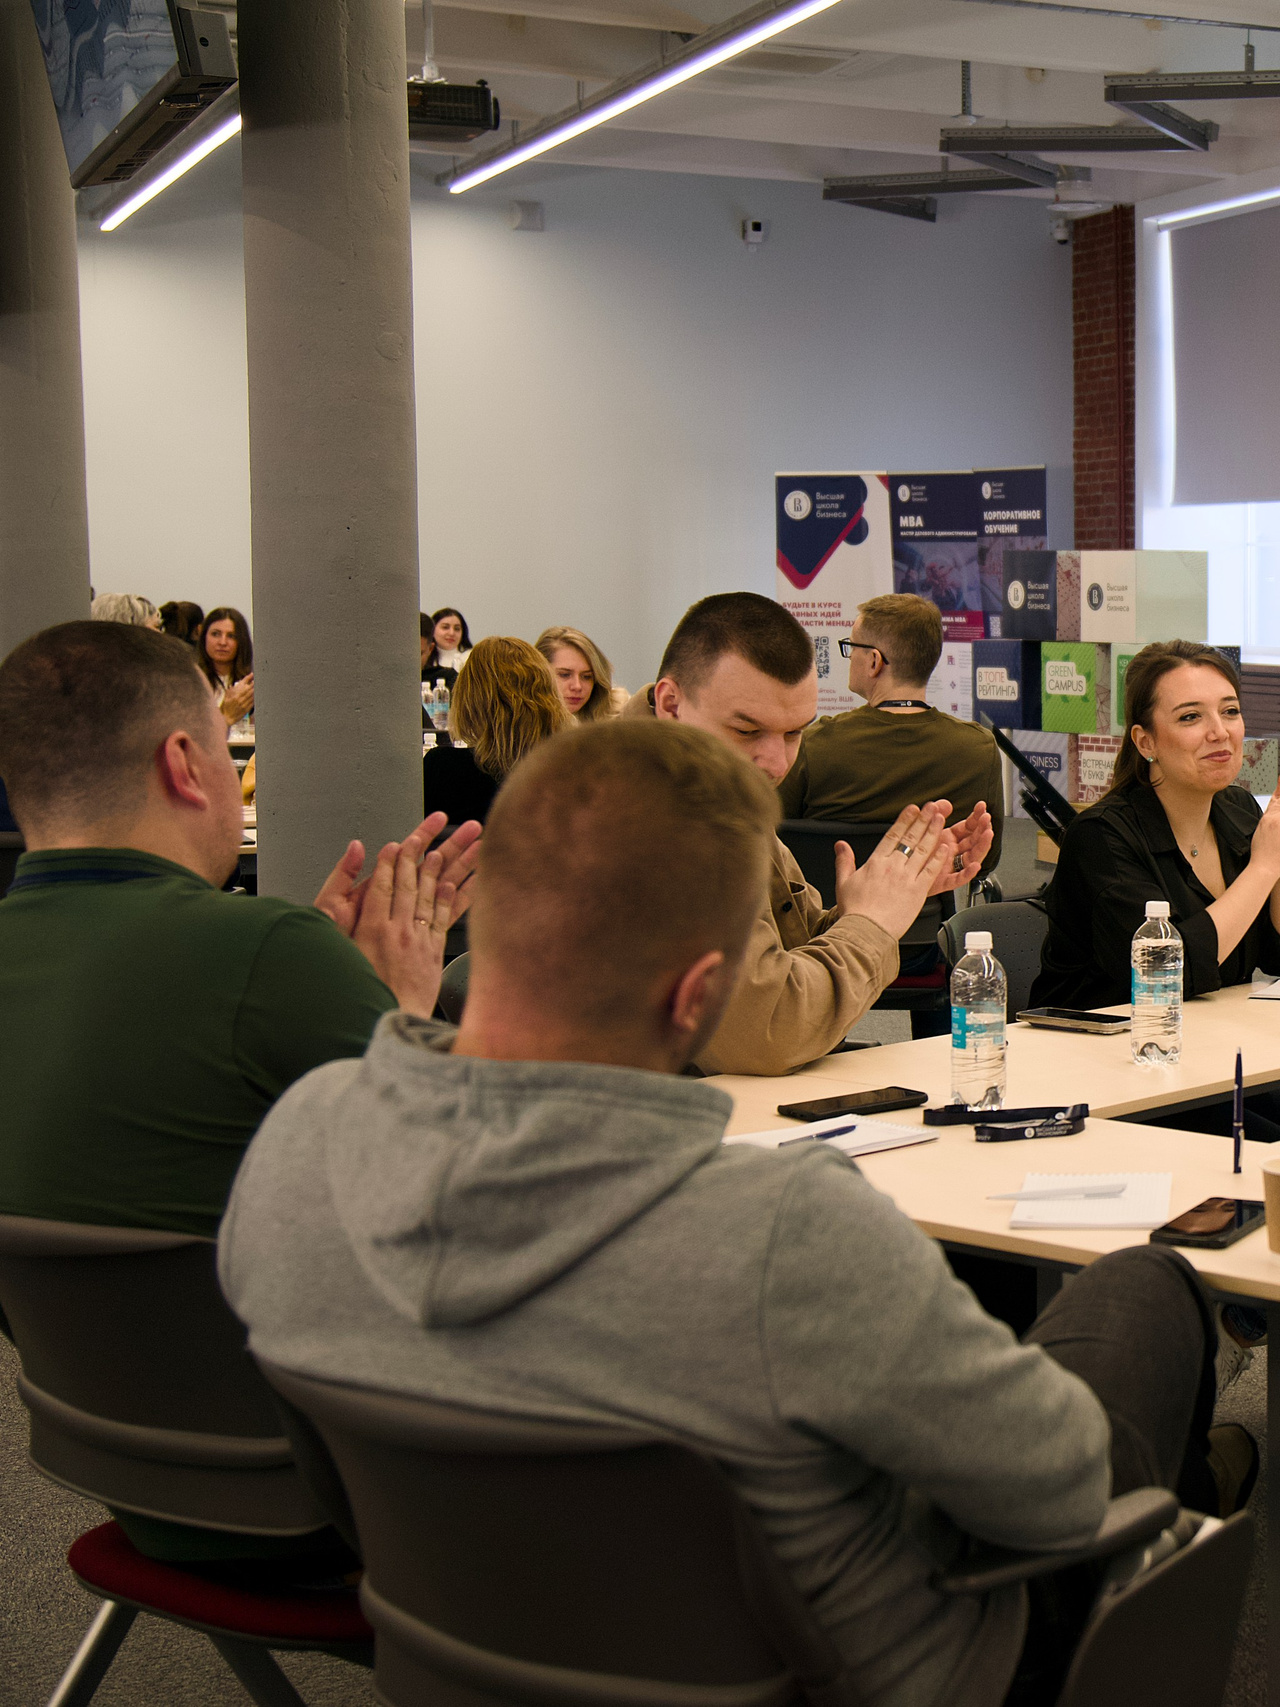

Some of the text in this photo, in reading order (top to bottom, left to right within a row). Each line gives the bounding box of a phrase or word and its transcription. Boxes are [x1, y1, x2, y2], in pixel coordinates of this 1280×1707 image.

[816, 492, 845, 500] Высшая
[984, 510, 1040, 520] КОРПОРАТИВНОЕ
[900, 516, 923, 527] MBA
[985, 524, 1018, 533] ОБУЧЕНИЕ
[1027, 580, 1049, 590] Высшая
[1107, 583, 1128, 592] Высшая
[1027, 602, 1050, 610] бизнеса
[1107, 604, 1129, 612] бизнеса
[820, 610, 841, 618] ИДЕЙ
[1048, 665, 1074, 677] GREEN
[979, 671, 1004, 682] В ТОПЕ
[979, 683, 1016, 697] РЕЙТИНГА
[1048, 680, 1084, 692] CAMPUS
[1029, 755, 1059, 768] USINESS
[1083, 758, 1115, 770] ВСТРЕЧАЕ
[1083, 770, 1104, 781] У БУКВ
